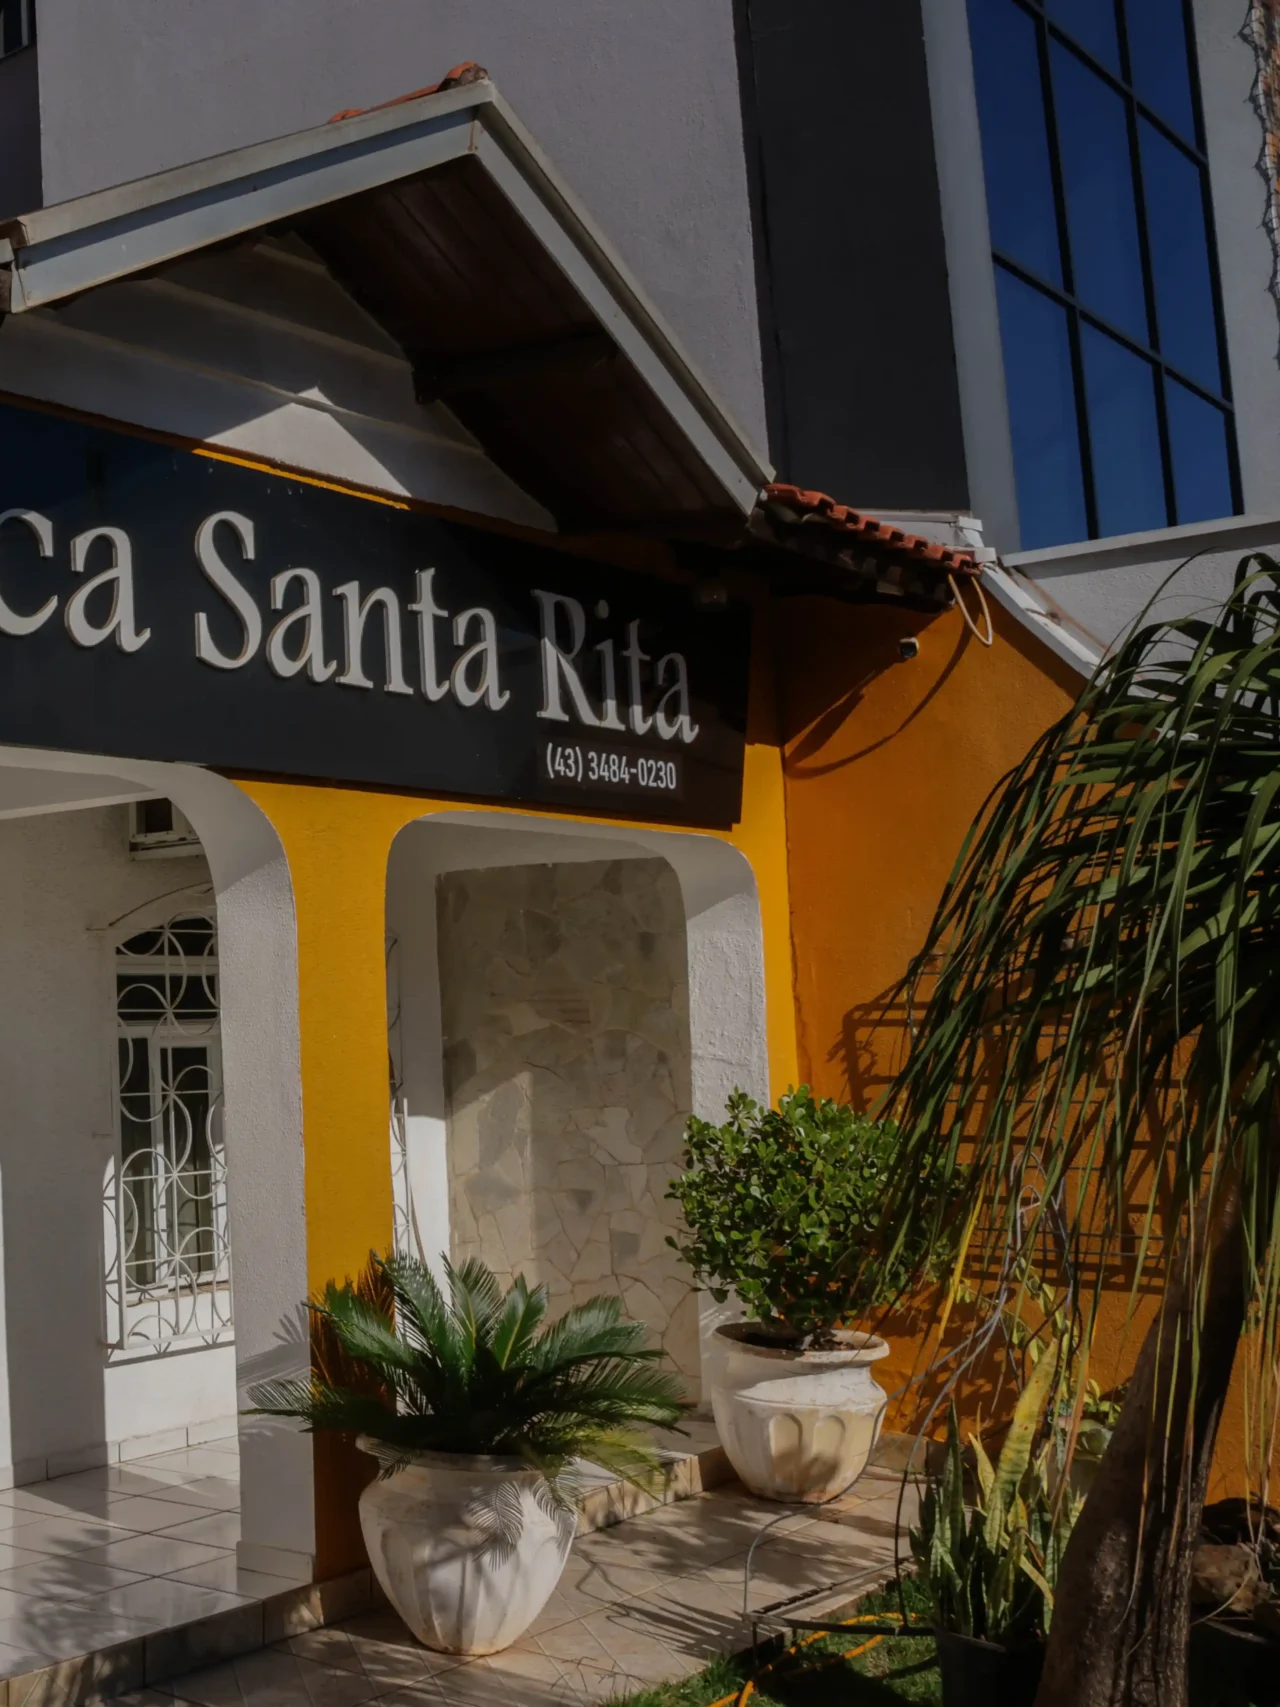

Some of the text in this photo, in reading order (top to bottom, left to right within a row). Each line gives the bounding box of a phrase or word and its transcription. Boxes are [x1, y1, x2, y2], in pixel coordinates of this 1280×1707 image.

[195, 511, 510, 711] Santa
[533, 589, 699, 743] Rita
[546, 742, 676, 789] (43) 3484-0230
